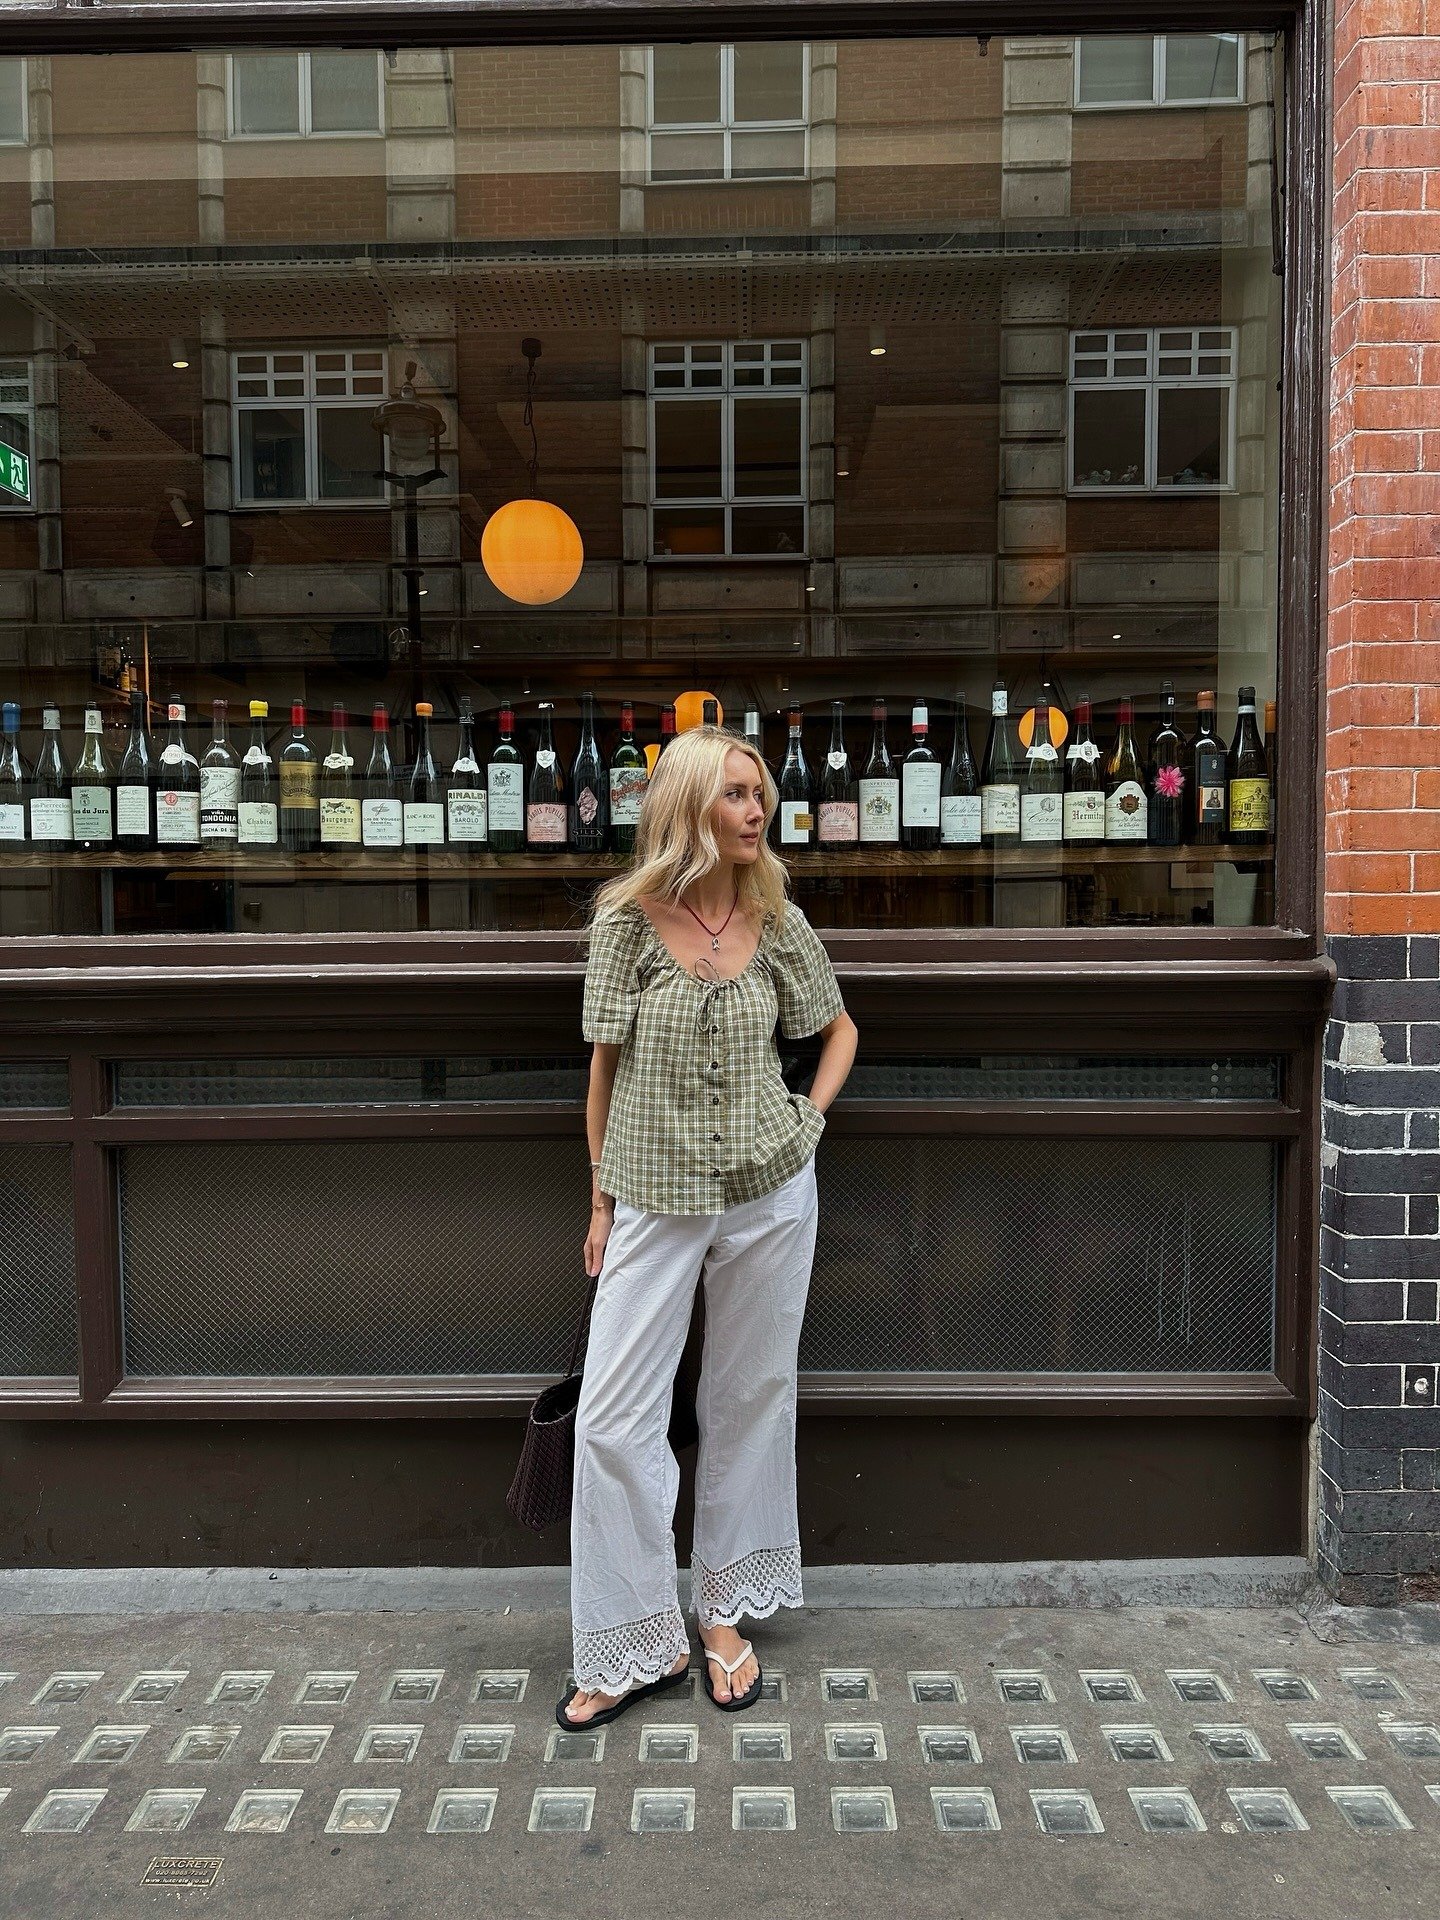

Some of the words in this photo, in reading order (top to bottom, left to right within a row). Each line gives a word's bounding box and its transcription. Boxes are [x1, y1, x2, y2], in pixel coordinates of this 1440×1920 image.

[321, 815, 354, 823] Bourgogne
[573, 828, 603, 836] SILEX
[153, 1860, 218, 1869] LUXCRETE
